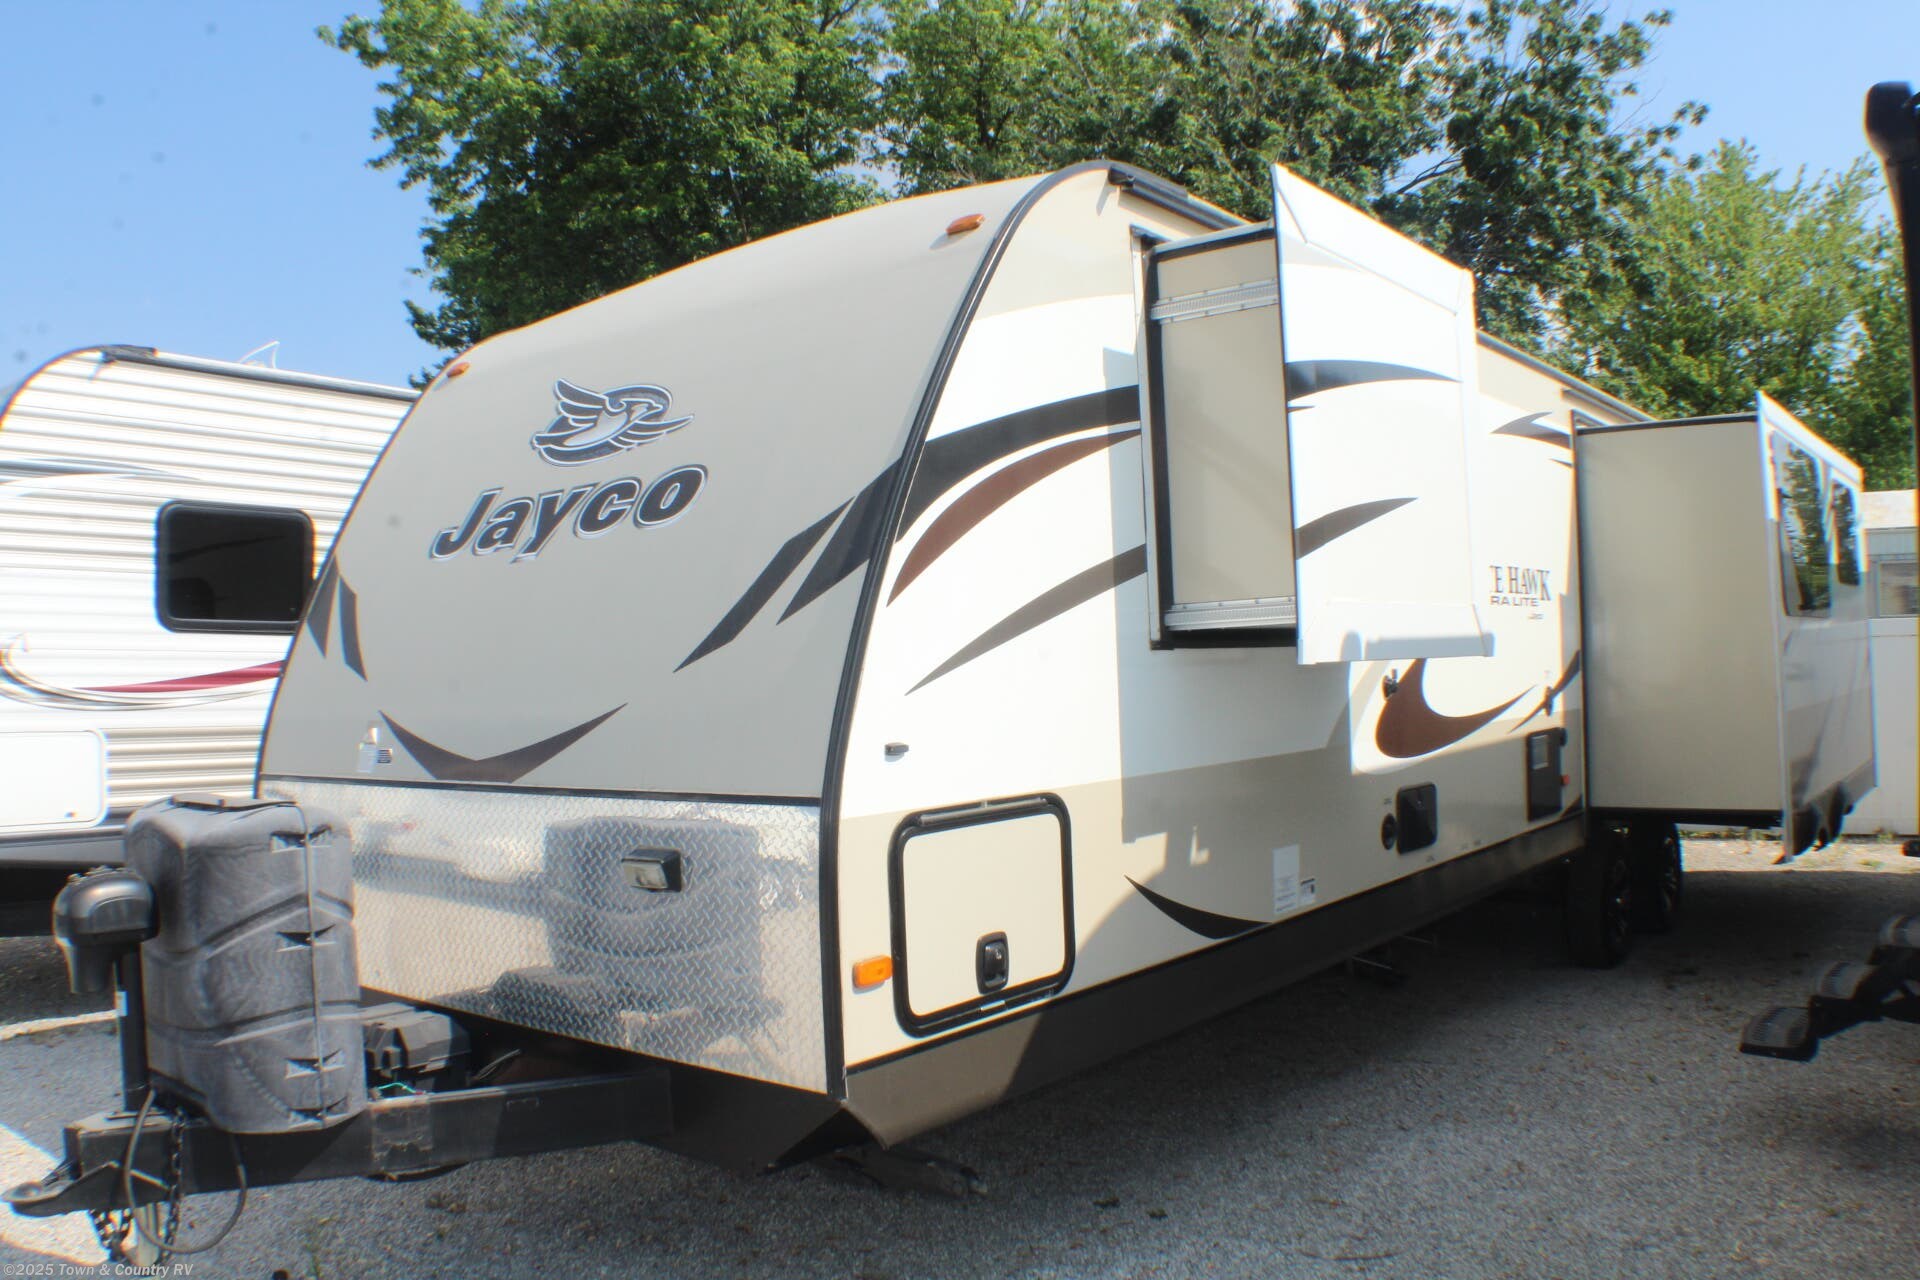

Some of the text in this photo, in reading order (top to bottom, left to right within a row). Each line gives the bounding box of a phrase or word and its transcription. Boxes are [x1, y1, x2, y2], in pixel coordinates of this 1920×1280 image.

[429, 464, 708, 564] Jayco
[1507, 566, 1551, 601] HAWK
[1512, 597, 1540, 607] LITE
